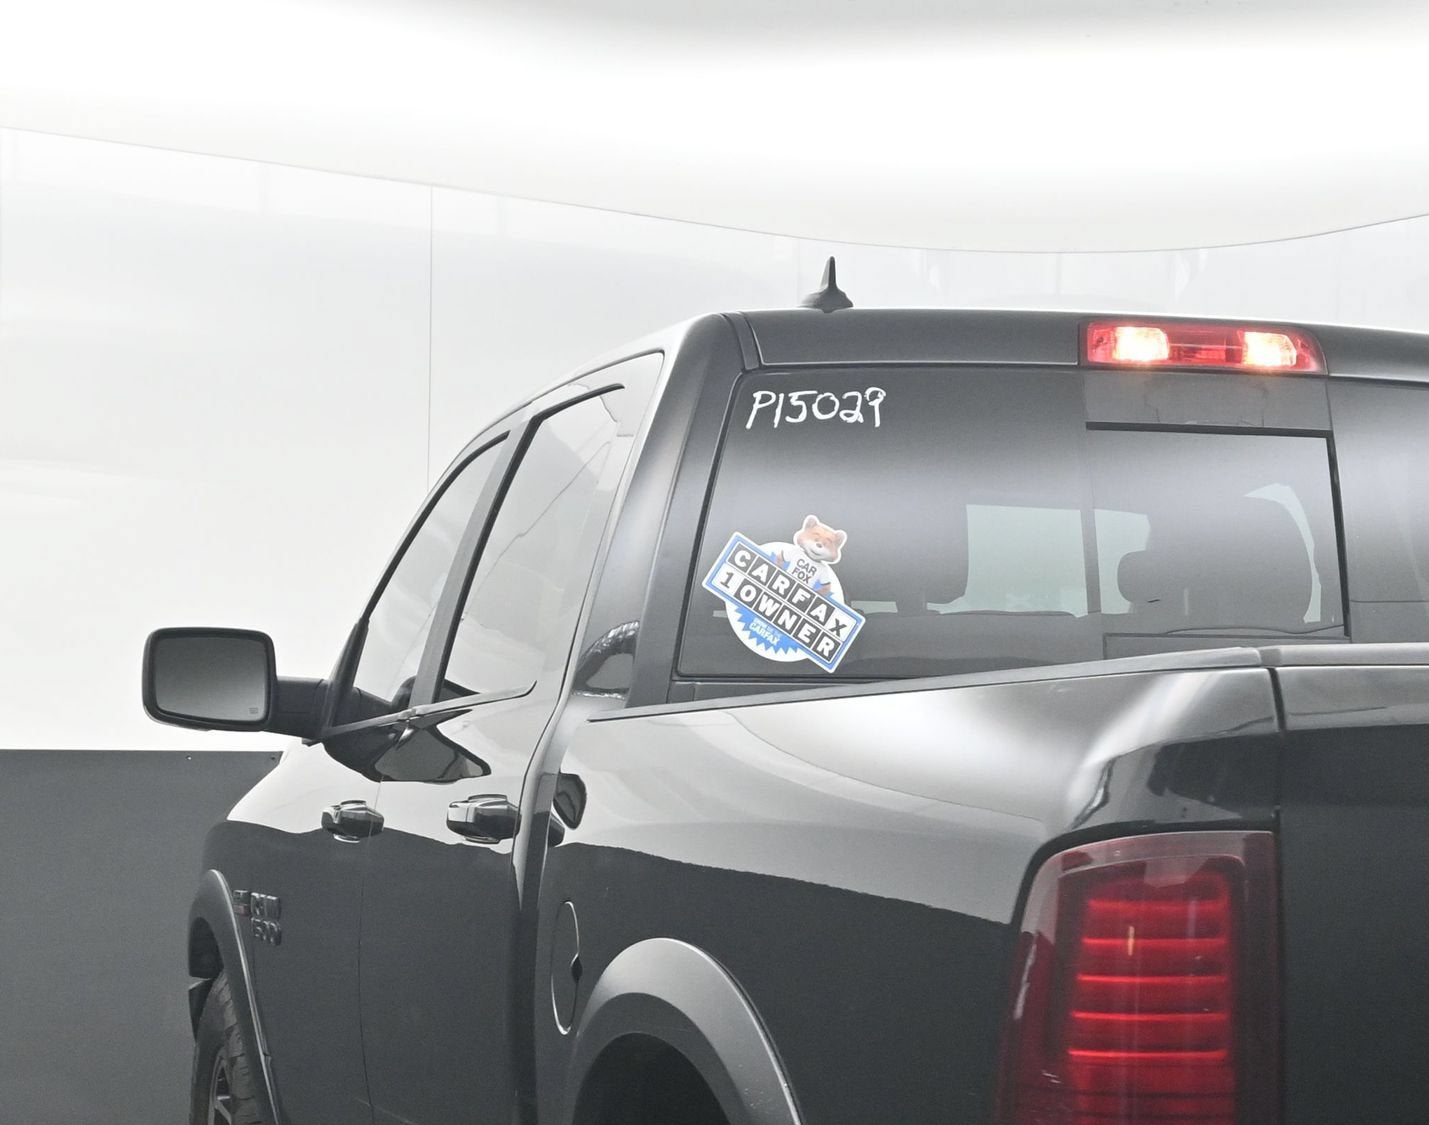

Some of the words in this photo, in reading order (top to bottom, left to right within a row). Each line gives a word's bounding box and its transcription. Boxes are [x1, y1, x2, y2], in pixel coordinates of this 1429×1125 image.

[746, 386, 886, 429] P15029
[792, 567, 812, 584] FOX
[796, 558, 816, 577] CAR
[733, 551, 848, 637] CARFAX
[739, 584, 836, 656] OWNER
